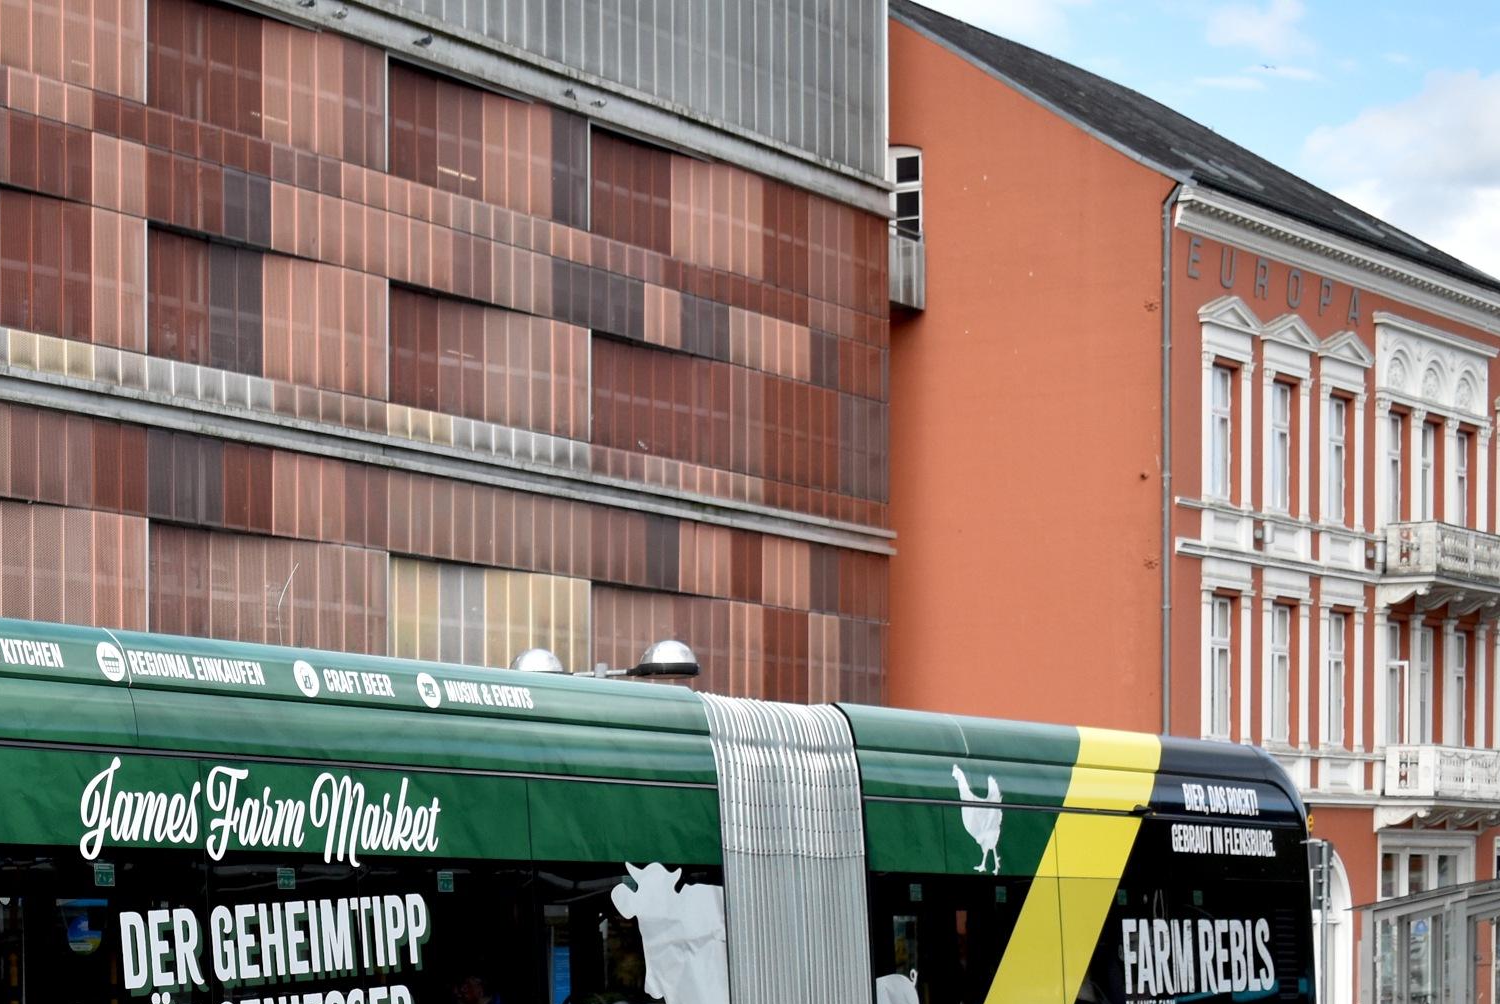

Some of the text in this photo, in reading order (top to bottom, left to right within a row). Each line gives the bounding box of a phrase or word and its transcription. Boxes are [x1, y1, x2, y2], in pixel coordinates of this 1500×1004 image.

[1187, 236, 1361, 326] EUROPA
[0, 637, 64, 668] KITCHEN
[128, 649, 266, 685] REGIONAL EINKAUFEN
[323, 668, 396, 698] CRAFT BEER
[443, 679, 535, 710] MUSIK & EVENTS
[79, 756, 442, 868] James Farm Market
[1182, 783, 1209, 815] BIER,
[1207, 785, 1227, 814] DAS
[1171, 823, 1276, 858] GEBRAUT IN FLENSBURG.
[119, 893, 427, 990] DER GEHEIMTIPP
[1121, 917, 1276, 996] FARM REBLS
